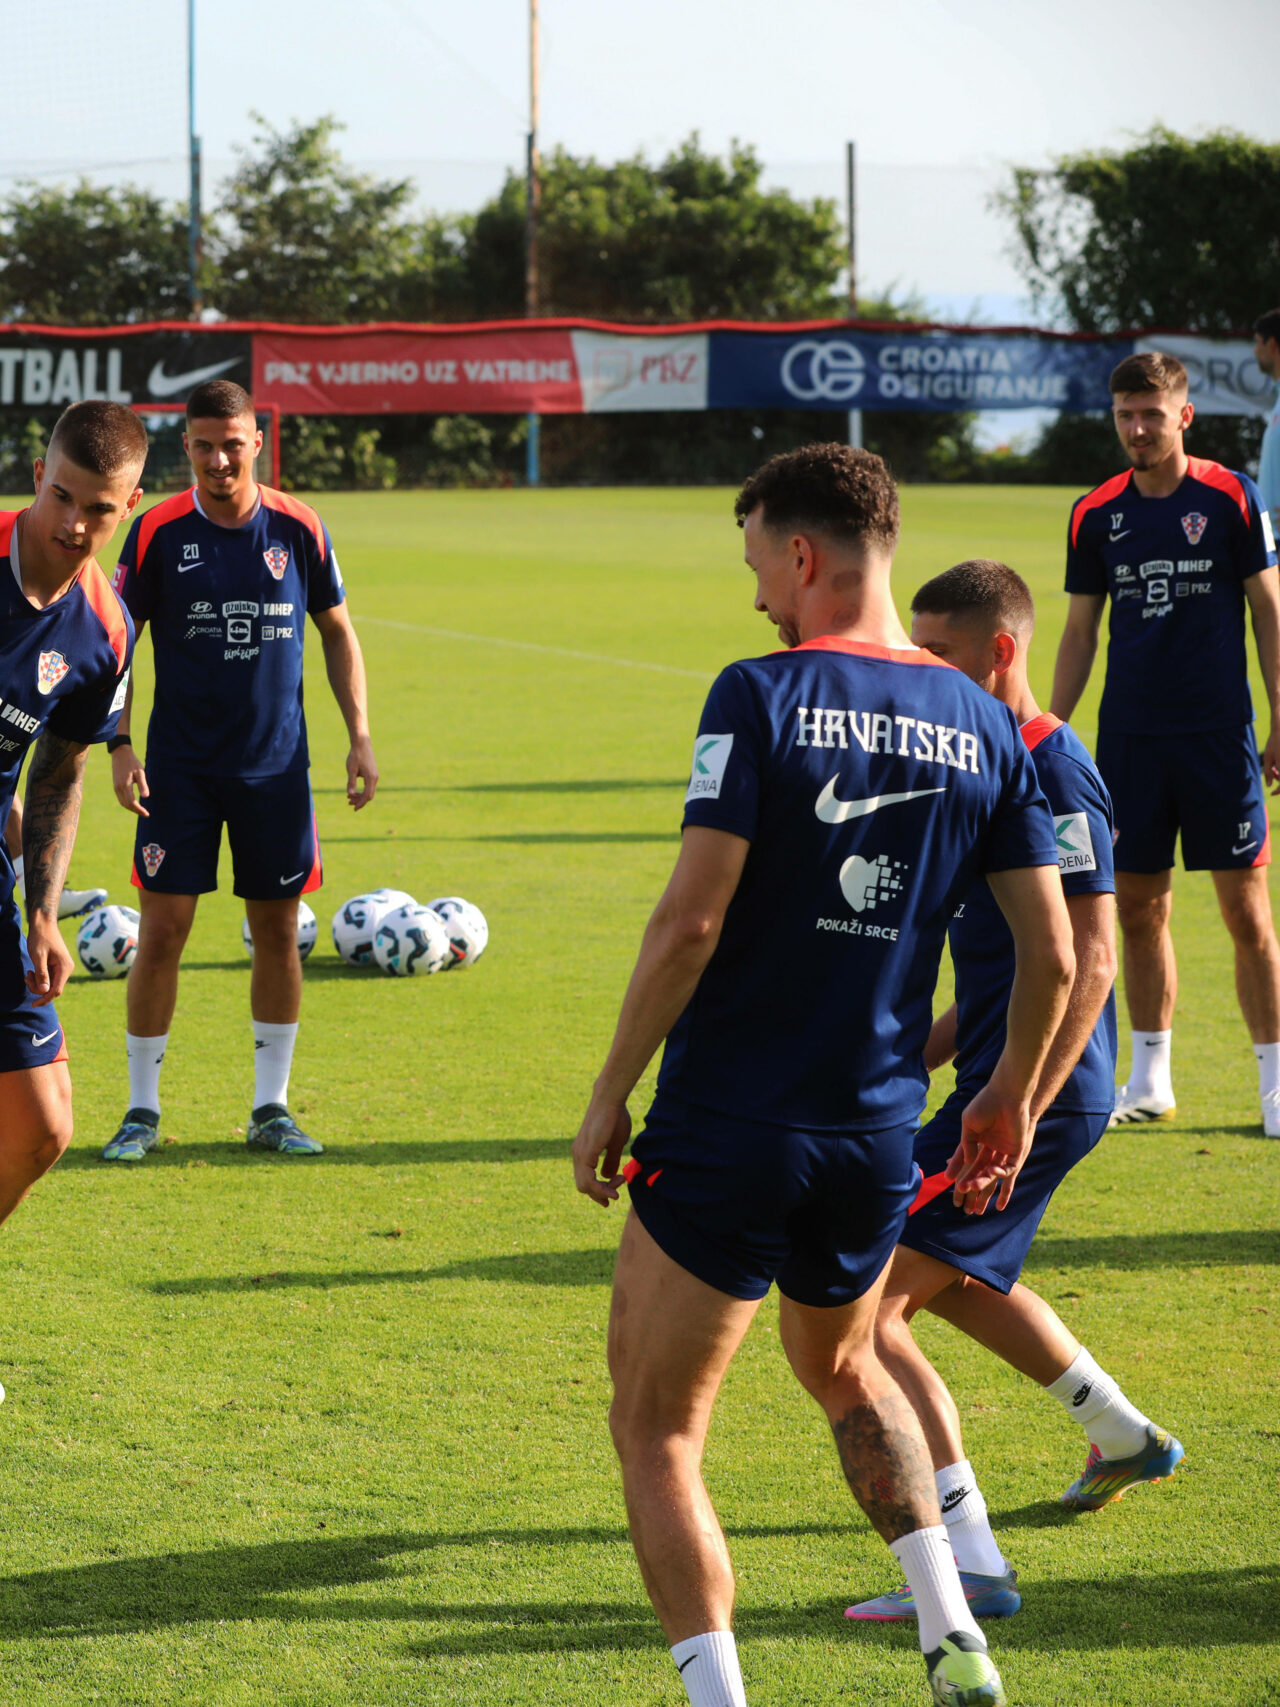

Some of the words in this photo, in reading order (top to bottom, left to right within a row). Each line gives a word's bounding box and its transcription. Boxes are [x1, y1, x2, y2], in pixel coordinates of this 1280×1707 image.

[878, 346, 1012, 373] CROATIA
[265, 361, 311, 385] PBZ
[317, 361, 419, 385] VJERNO
[424, 360, 460, 384] UZ
[463, 359, 572, 383] VATRENE
[878, 373, 1070, 401] OSIGURANJE
[1110, 513, 1124, 530] 17
[183, 543, 200, 560] 20
[275, 603, 294, 617] HEP
[276, 627, 293, 639] PBZ
[796, 706, 980, 775] HRVATSKA
[1238, 821, 1251, 840] 17
[816, 917, 863, 936] POKAŽI
[864, 925, 900, 942] SRCE
[944, 1486, 966, 1505] NIKE
